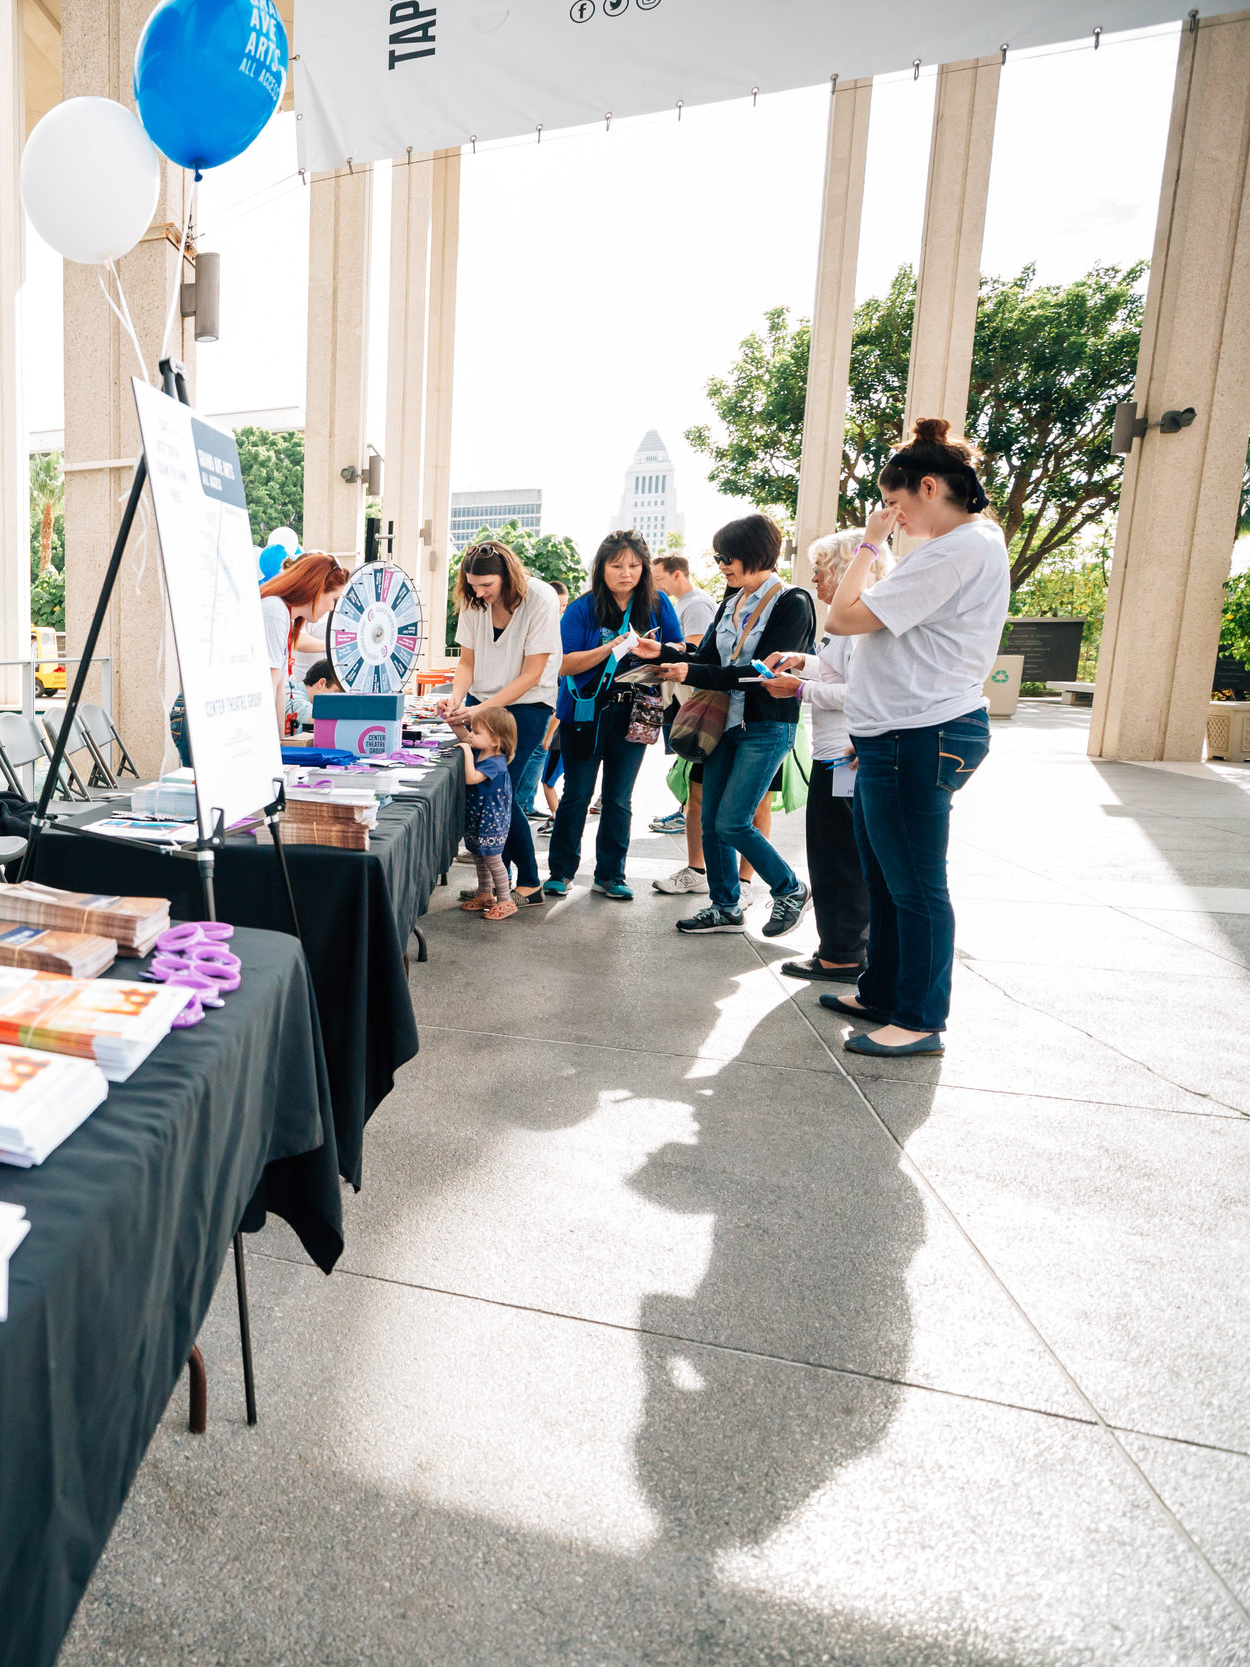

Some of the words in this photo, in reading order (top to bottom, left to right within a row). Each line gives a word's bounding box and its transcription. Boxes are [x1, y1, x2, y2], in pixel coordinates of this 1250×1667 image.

[249, 6, 278, 42] AVE
[244, 30, 282, 73] ARTS
[238, 57, 257, 78] ALL
[365, 740, 387, 748] THEATRE
